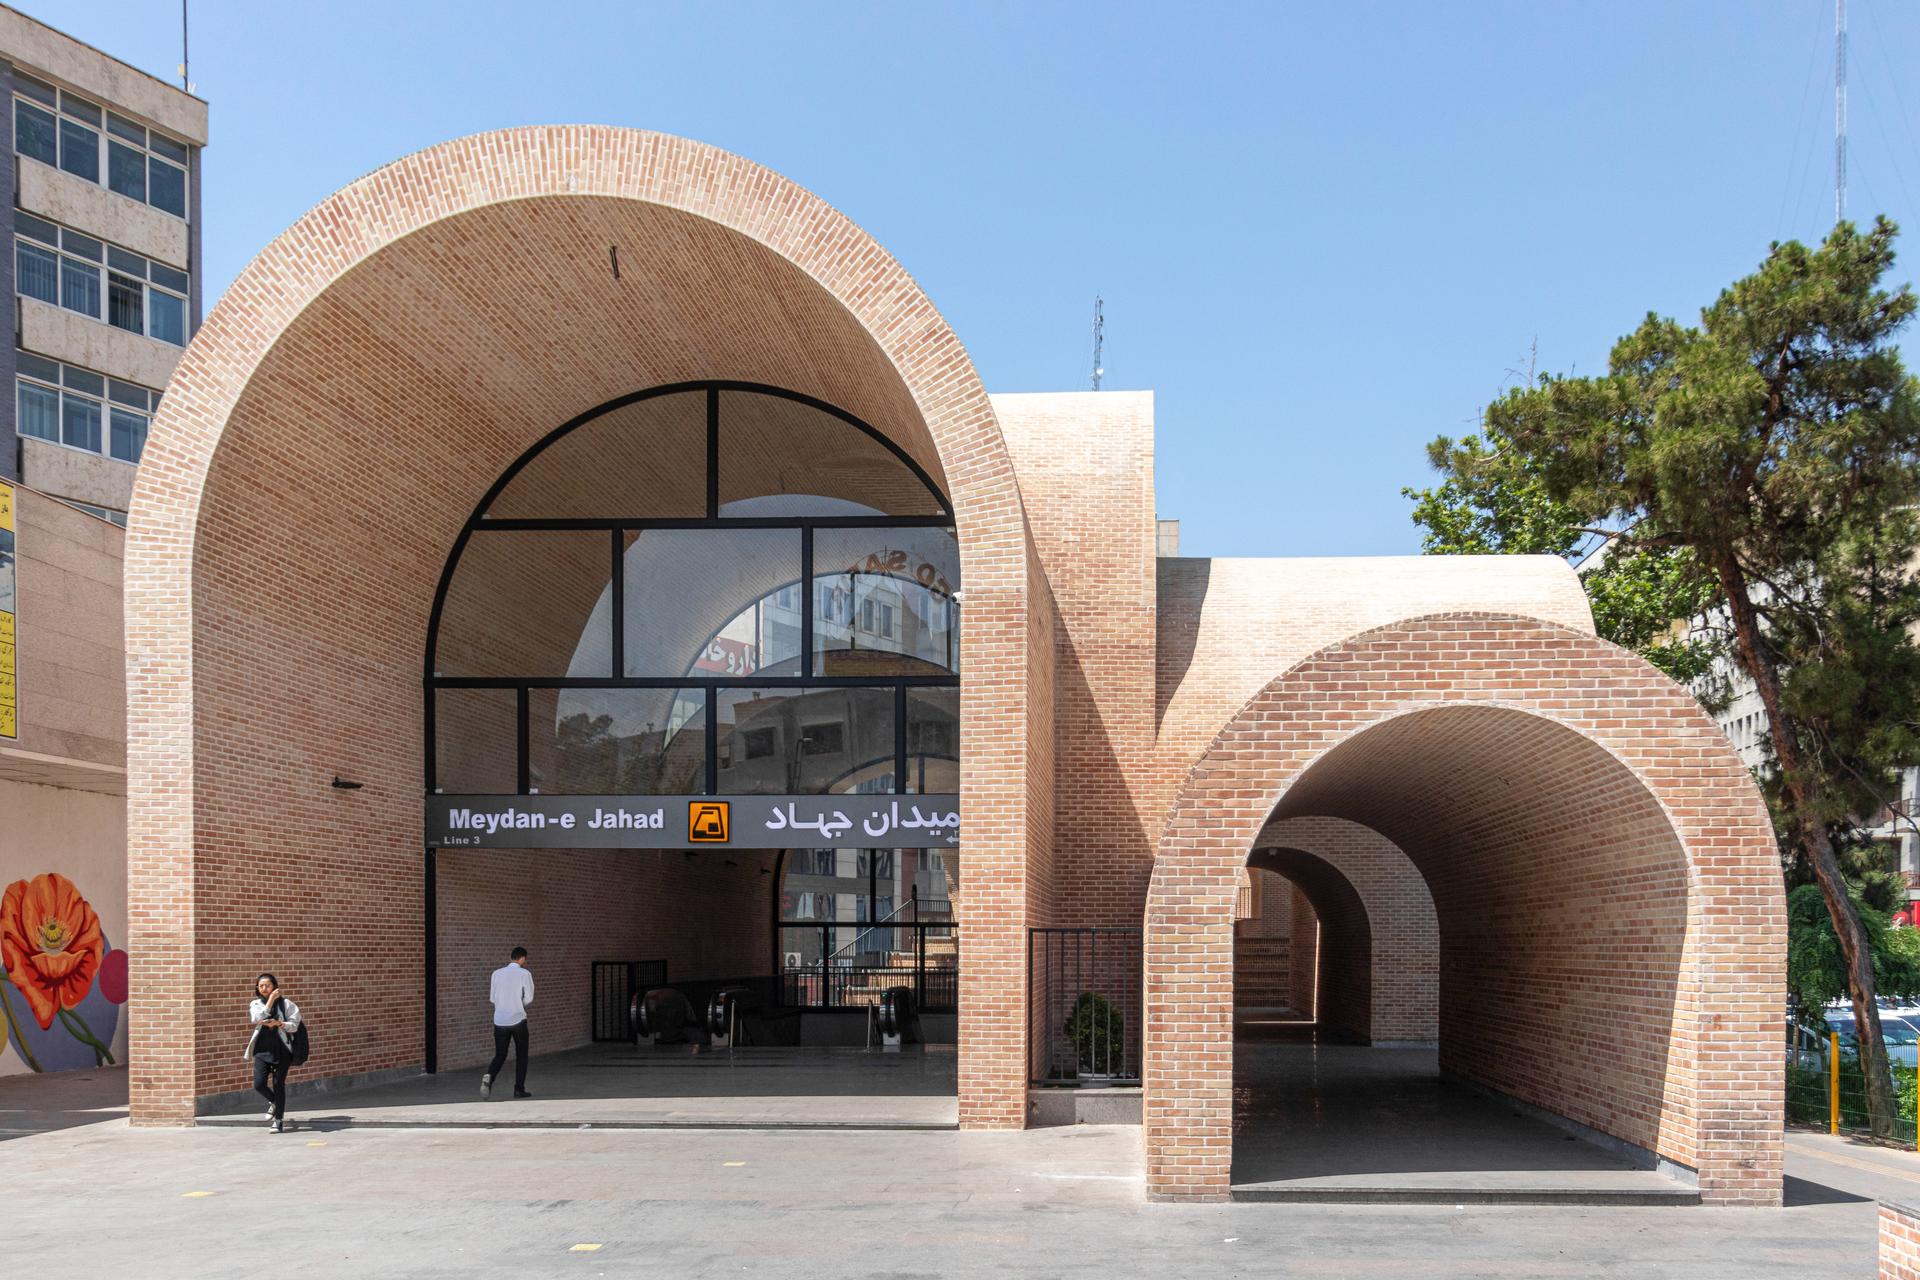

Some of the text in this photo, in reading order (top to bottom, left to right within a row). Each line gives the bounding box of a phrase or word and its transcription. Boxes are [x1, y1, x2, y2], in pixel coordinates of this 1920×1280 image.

[449, 808, 664, 834] Meydan-e Jahad
[863, 801, 960, 837] میدان
[444, 836, 481, 845] Line 3
